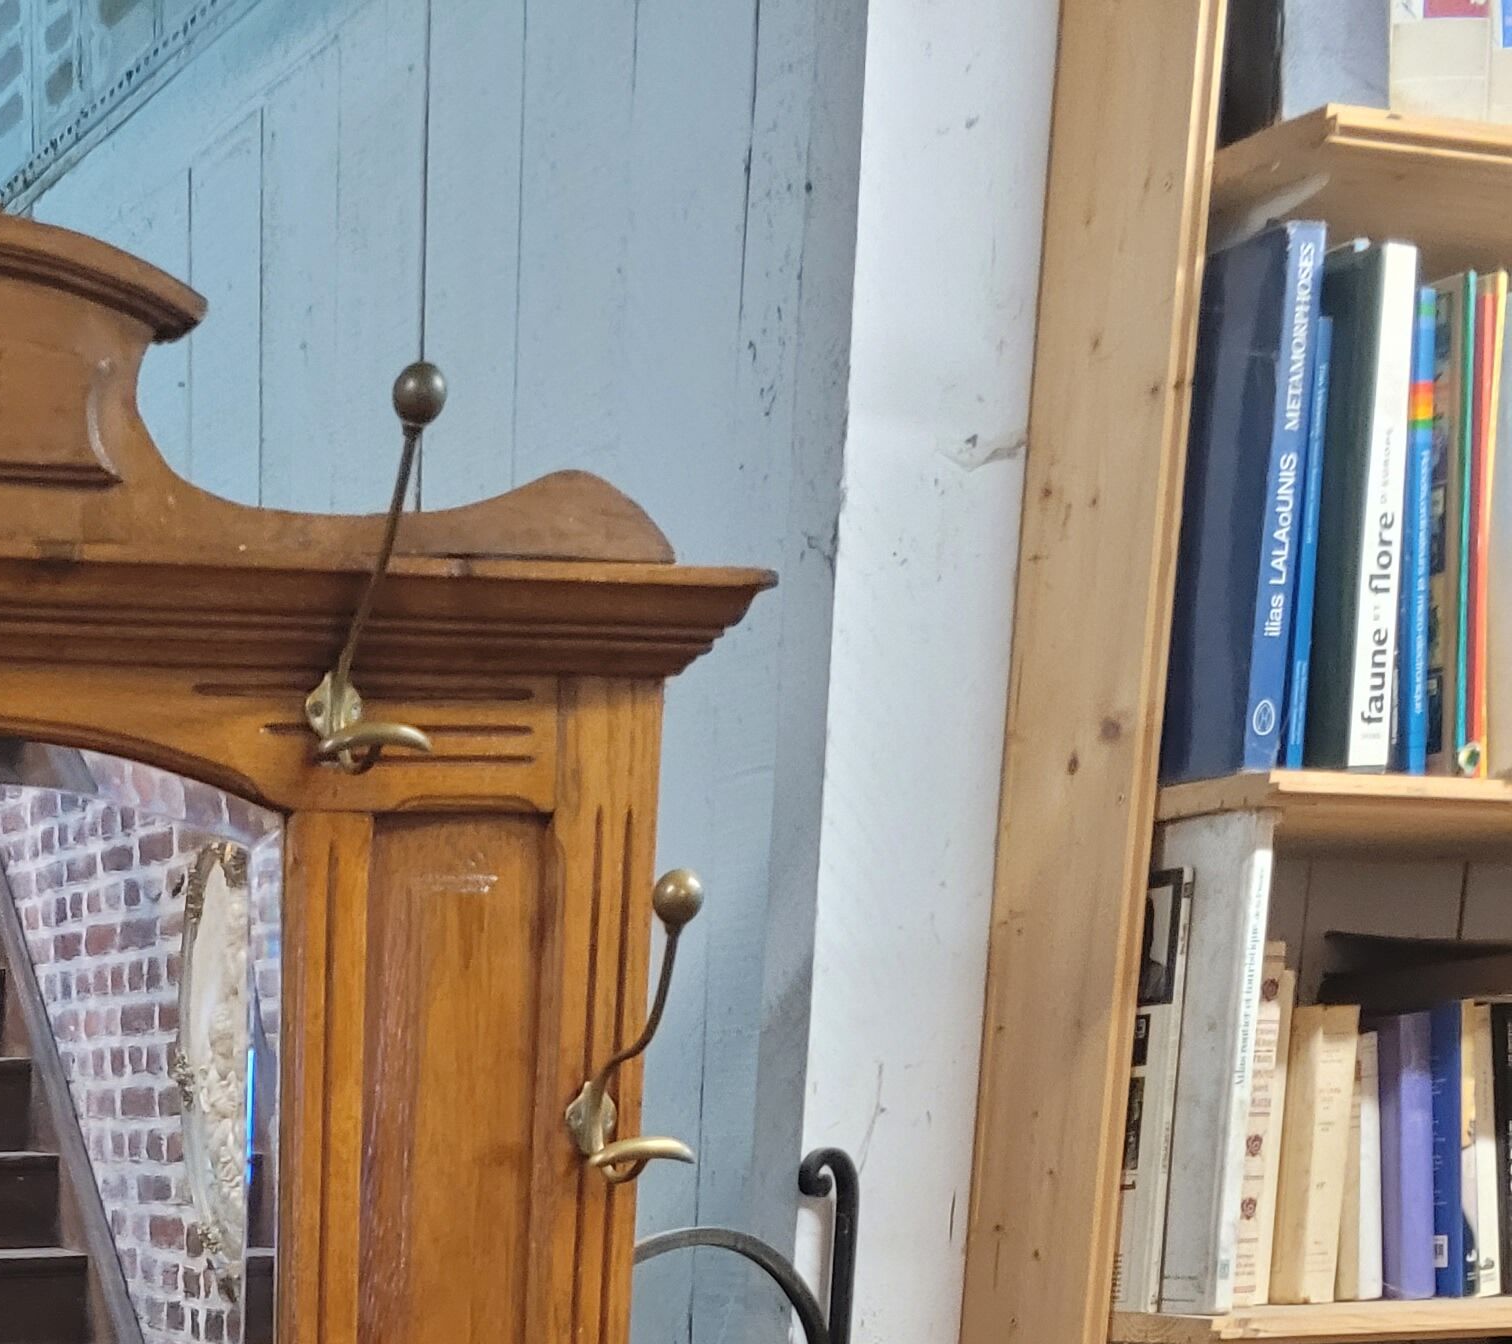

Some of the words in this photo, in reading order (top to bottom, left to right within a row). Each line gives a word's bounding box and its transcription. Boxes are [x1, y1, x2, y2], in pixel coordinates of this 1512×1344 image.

[1284, 241, 1317, 432] METAMORPHOSES
[1368, 511, 1396, 594] flore
[1263, 593, 1285, 638] ilias
[1360, 627, 1389, 727] faune
